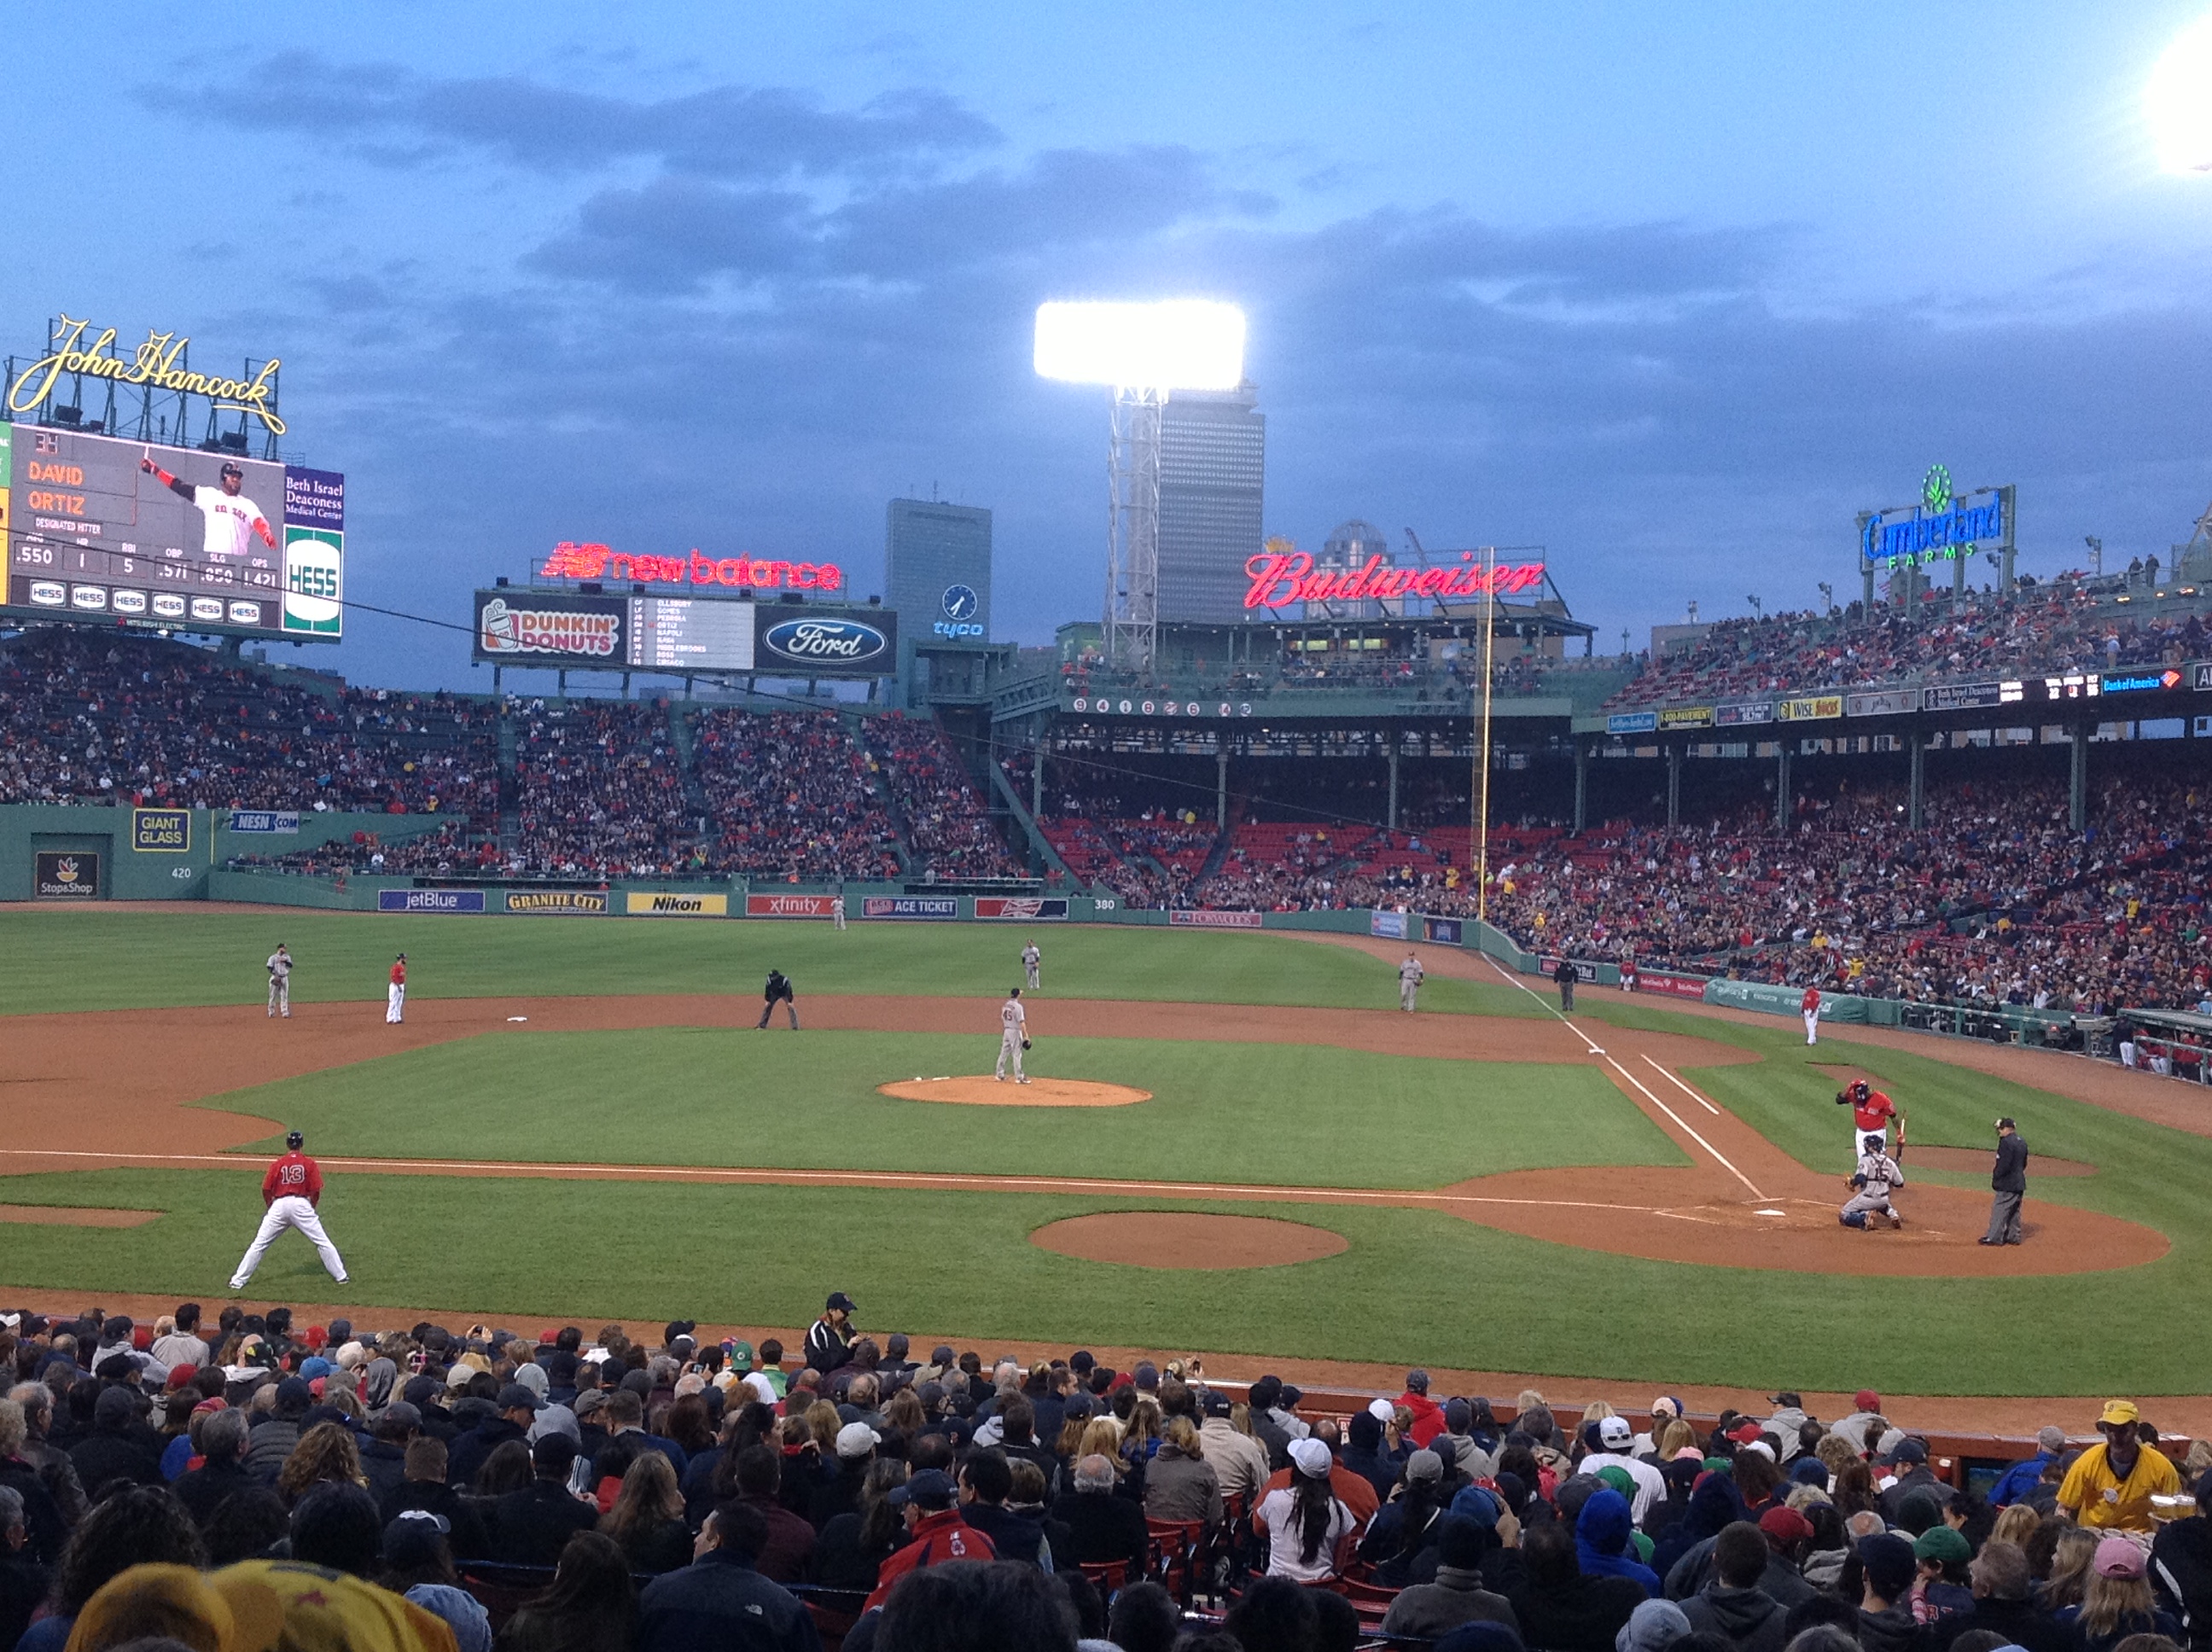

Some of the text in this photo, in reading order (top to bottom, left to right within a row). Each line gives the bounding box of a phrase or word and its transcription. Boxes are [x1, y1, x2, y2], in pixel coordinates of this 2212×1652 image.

[9, 313, 287, 435] John Hancock
[36, 433, 59, 454] 34
[29, 461, 84, 486] DAVID
[286, 477, 343, 497] Beth Israel
[28, 491, 84, 515] ORTIZ
[286, 491, 342, 509] Deaconess
[285, 504, 342, 520] Medical Center
[36, 518, 101, 534] DESIGNATED HITTER
[1863, 489, 2000, 561] Cumberland
[16, 546, 53, 564] .550
[124, 558, 133, 573] 5
[121, 543, 137, 553] RBI
[165, 548, 183, 558] OBP
[252, 557, 268, 568] OPS
[1888, 542, 1976, 570] FARMS
[613, 553, 686, 581] new
[690, 547, 841, 590] balance
[289, 564, 337, 597] HESS
[1243, 550, 1545, 608] Budweiser
[33, 588, 62, 599] HESS
[75, 591, 103, 602] HESS
[116, 596, 143, 607] HESS
[155, 601, 182, 610] HESS
[194, 604, 220, 614] HESS
[231, 607, 258, 617] HESS
[522, 614, 616, 633] DUNKIN'
[933, 620, 984, 638] tyco
[522, 632, 611, 652] DONUTS
[787, 624, 862, 657] Ford
[2104, 680, 2121, 692] Bank
[2129, 677, 2160, 689] America
[142, 817, 180, 830] GIANT
[139, 831, 183, 844] GLASS
[172, 868, 192, 879] 420
[405, 893, 458, 910] jetBlue
[509, 893, 604, 910] GRANITE CITY
[652, 895, 702, 912] Nikon
[770, 897, 820, 915] xfinity
[894, 900, 916, 912] ACE
[919, 901, 955, 912] TICKET
[1095, 899, 1115, 910] 380
[1003, 1009, 1012, 1021] 45
[281, 1165, 305, 1184] 13
